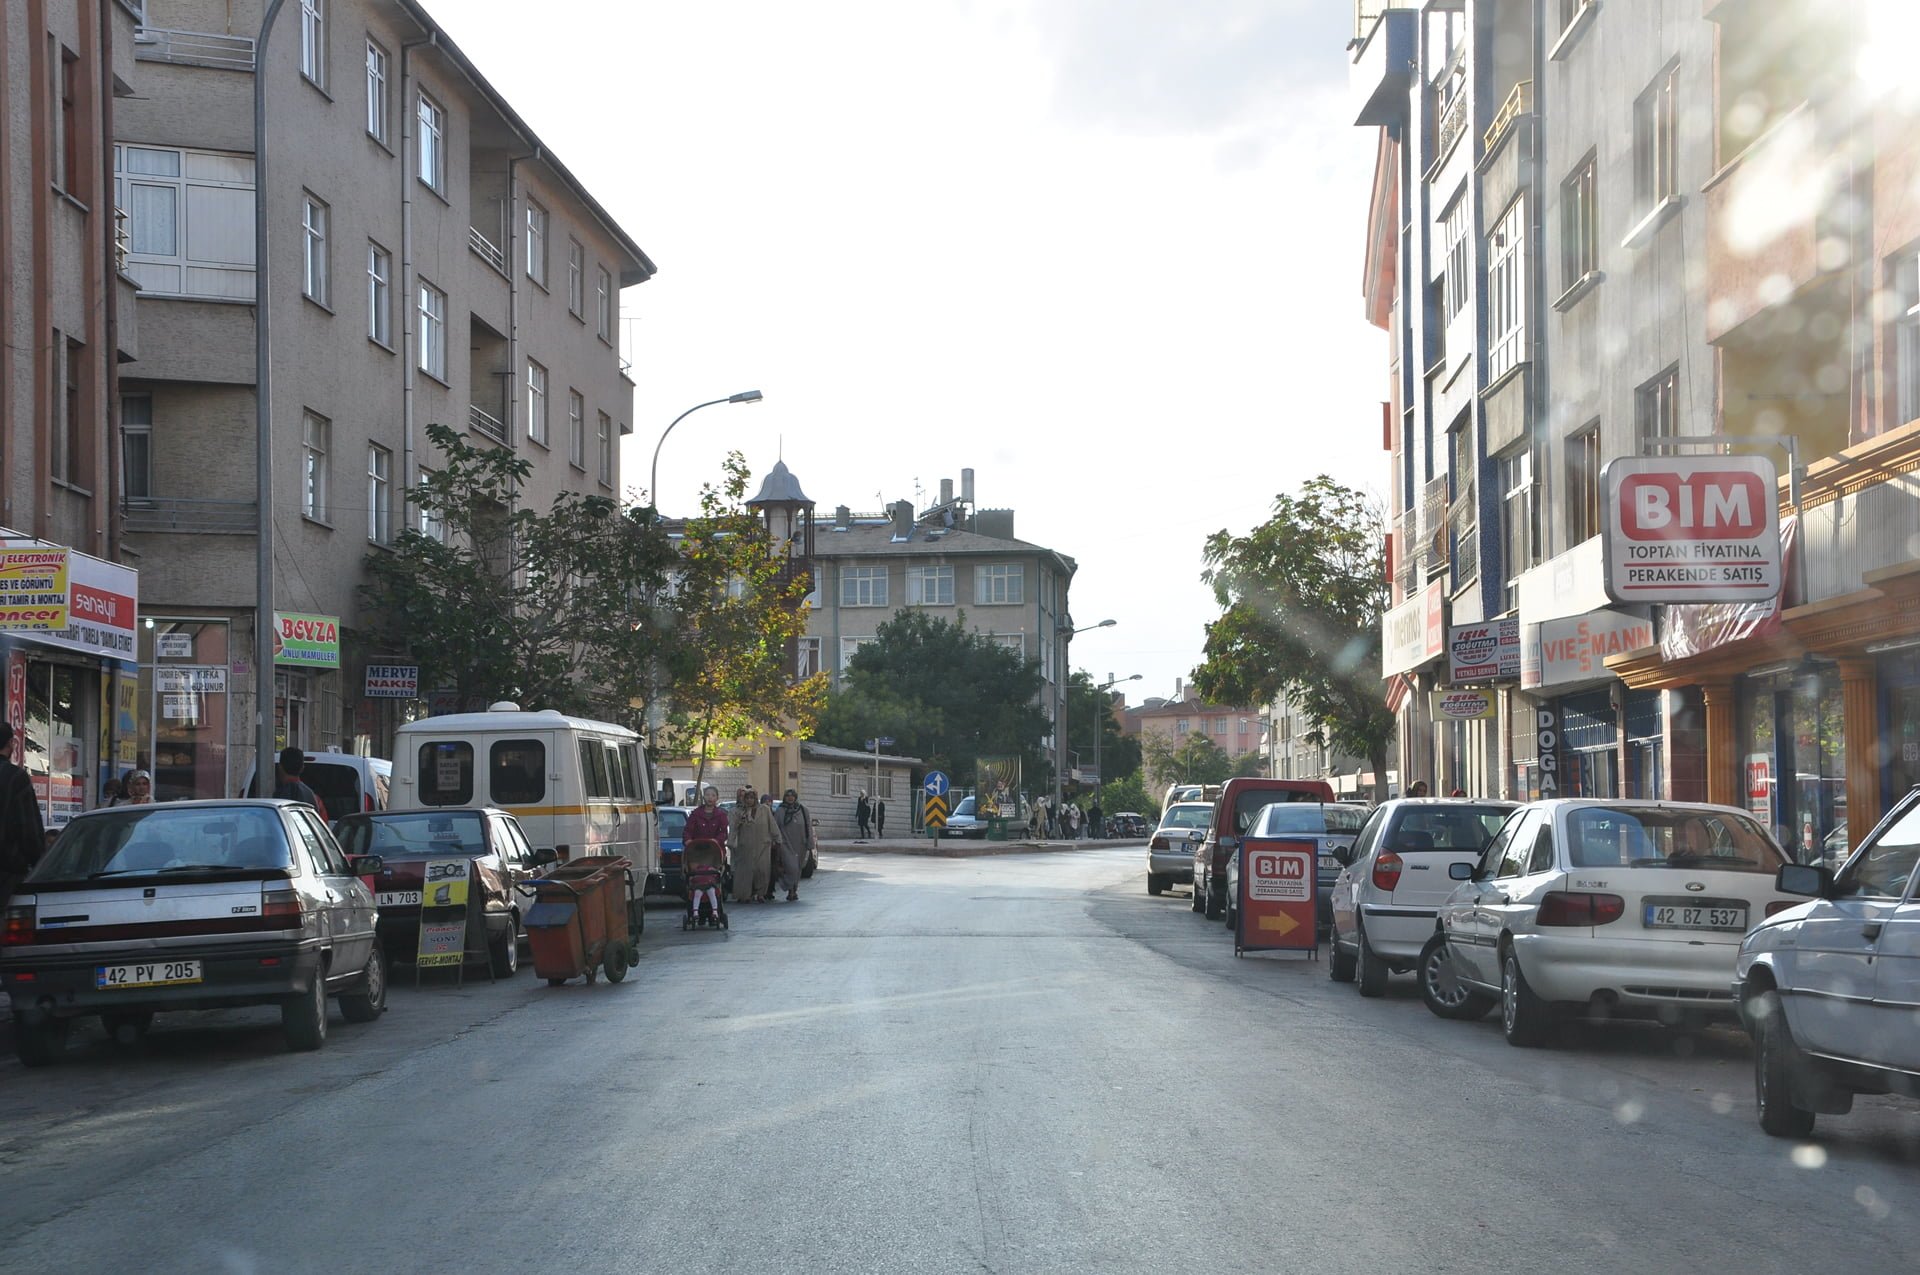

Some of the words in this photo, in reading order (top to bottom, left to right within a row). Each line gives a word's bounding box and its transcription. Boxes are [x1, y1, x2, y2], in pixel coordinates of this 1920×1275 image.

[1629, 545, 1688, 559] TOPTAN
[1694, 542, 1762, 557] FİYATINA
[7, 553, 66, 563] ELEKTRONİK
[1629, 568, 1717, 582] PERAKENDE
[1723, 567, 1763, 582] SATIŞ
[10, 579, 19, 590] VE
[20, 576, 54, 590] GÖRÜNTÜ
[39, 593, 65, 605] MONTAJ
[281, 617, 337, 643] BEYZA
[368, 667, 417, 679] MERVE
[368, 679, 417, 690] NAKIŞ
[380, 893, 393, 905] LN
[399, 892, 418, 904] 703
[1657, 908, 1674, 924] 42
[1683, 908, 1702, 925] BZ
[1710, 910, 1738, 926] 537
[109, 967, 127, 984] 42
[136, 965, 154, 982] PV
[165, 962, 194, 979] 205
